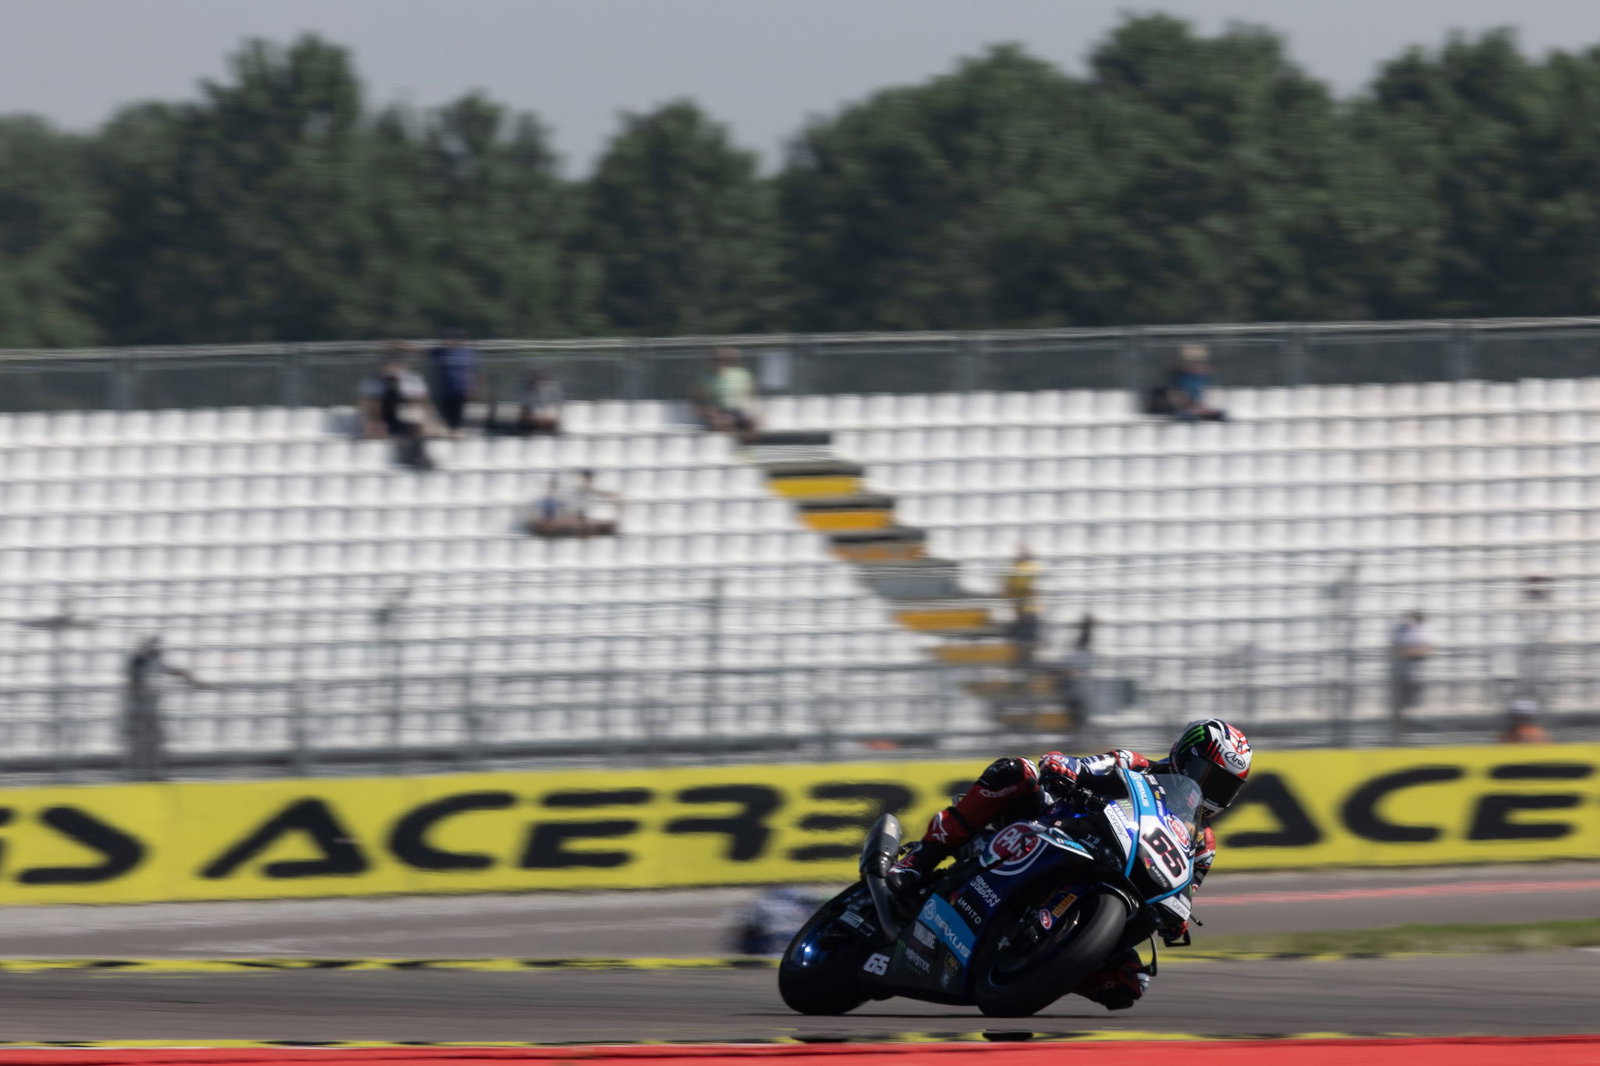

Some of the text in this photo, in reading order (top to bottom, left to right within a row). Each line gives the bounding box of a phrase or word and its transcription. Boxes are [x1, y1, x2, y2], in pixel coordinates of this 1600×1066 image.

[1226, 754, 1245, 767] Arai
[193, 777, 984, 880] ACERB
[1142, 827, 1187, 878] 65
[957, 897, 982, 925] AMPITO
[863, 952, 891, 976] 65
